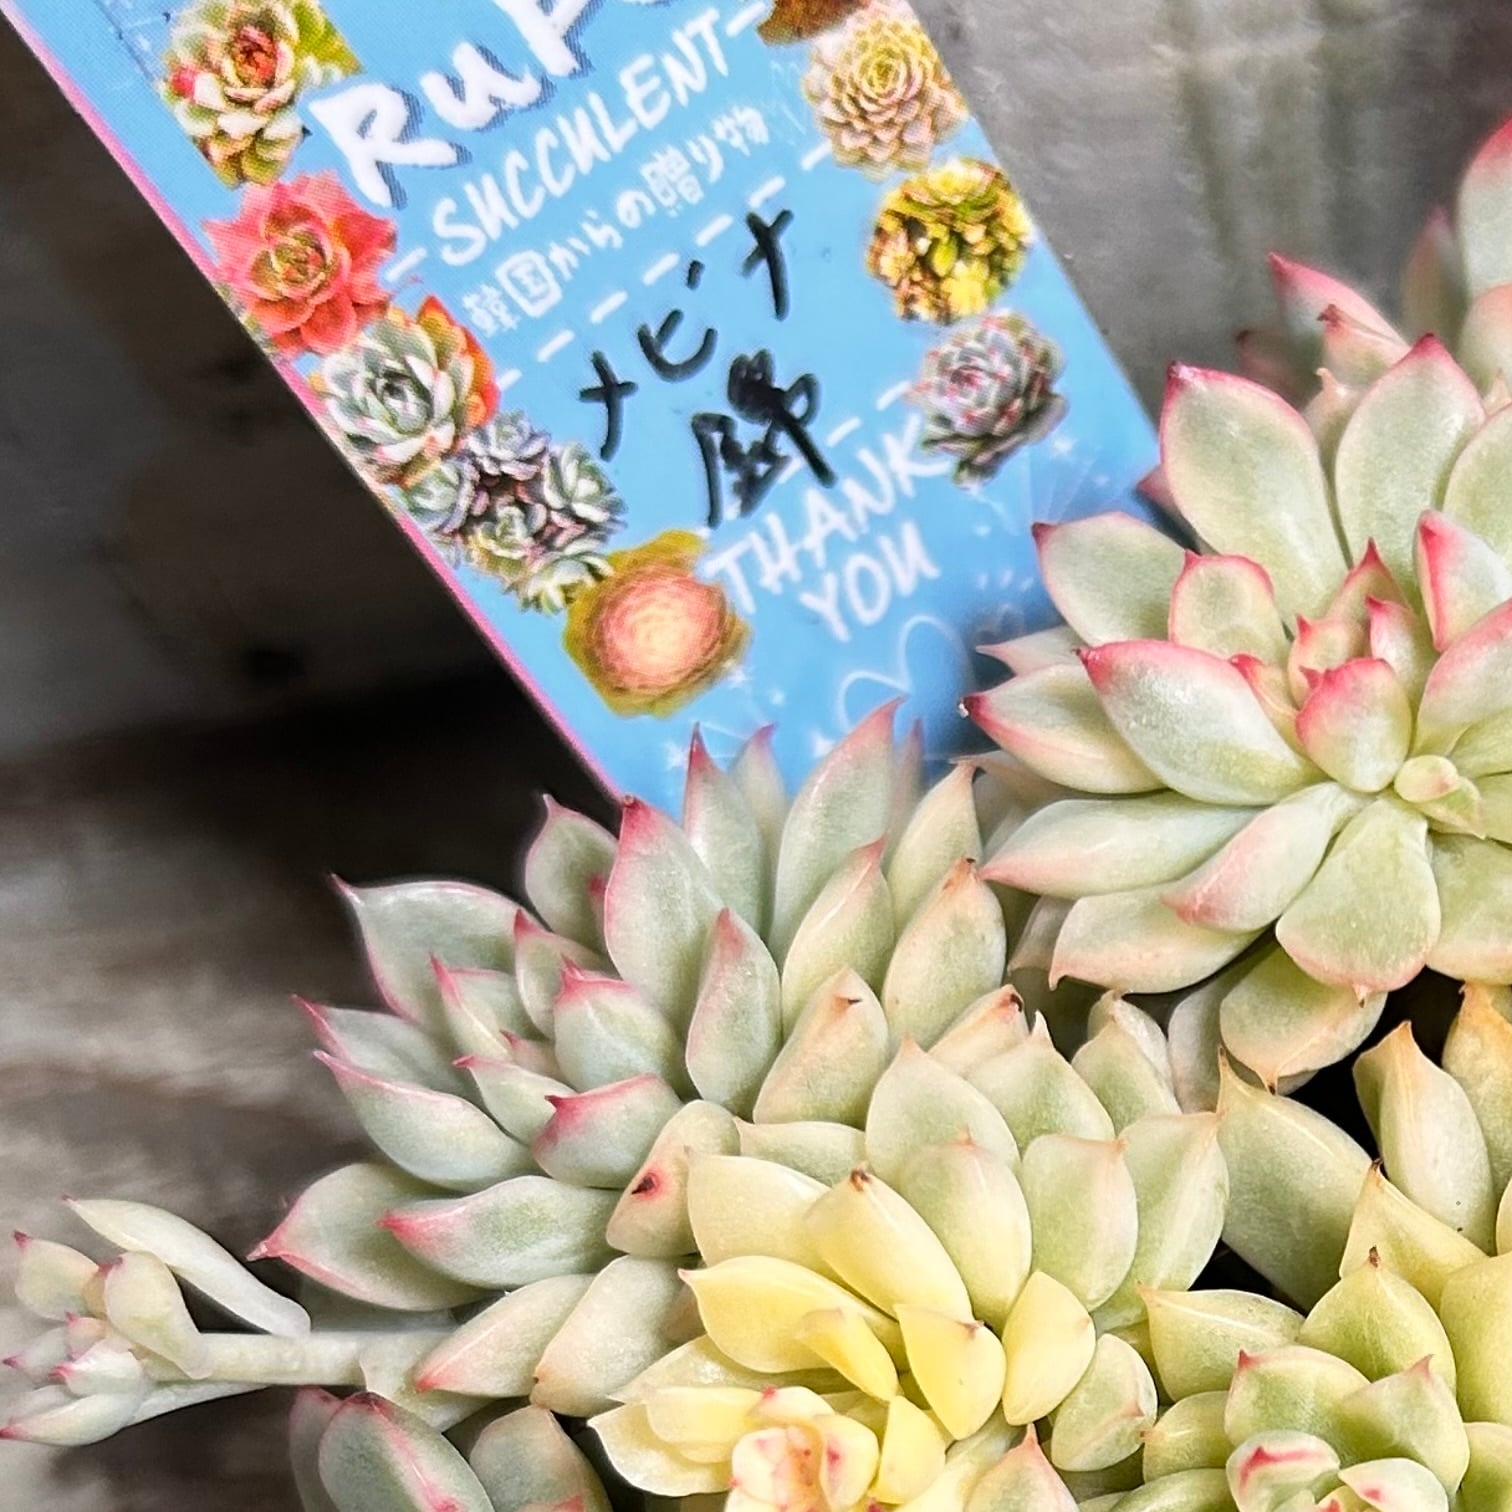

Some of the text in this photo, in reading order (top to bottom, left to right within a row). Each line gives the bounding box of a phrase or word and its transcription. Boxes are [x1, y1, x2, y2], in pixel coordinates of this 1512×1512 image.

[432, 8, 728, 266] SUCCULENT
[460, 105, 770, 338] 韓国からの贈り物
[702, 412, 953, 615] THANK
[799, 520, 941, 642] YOU
